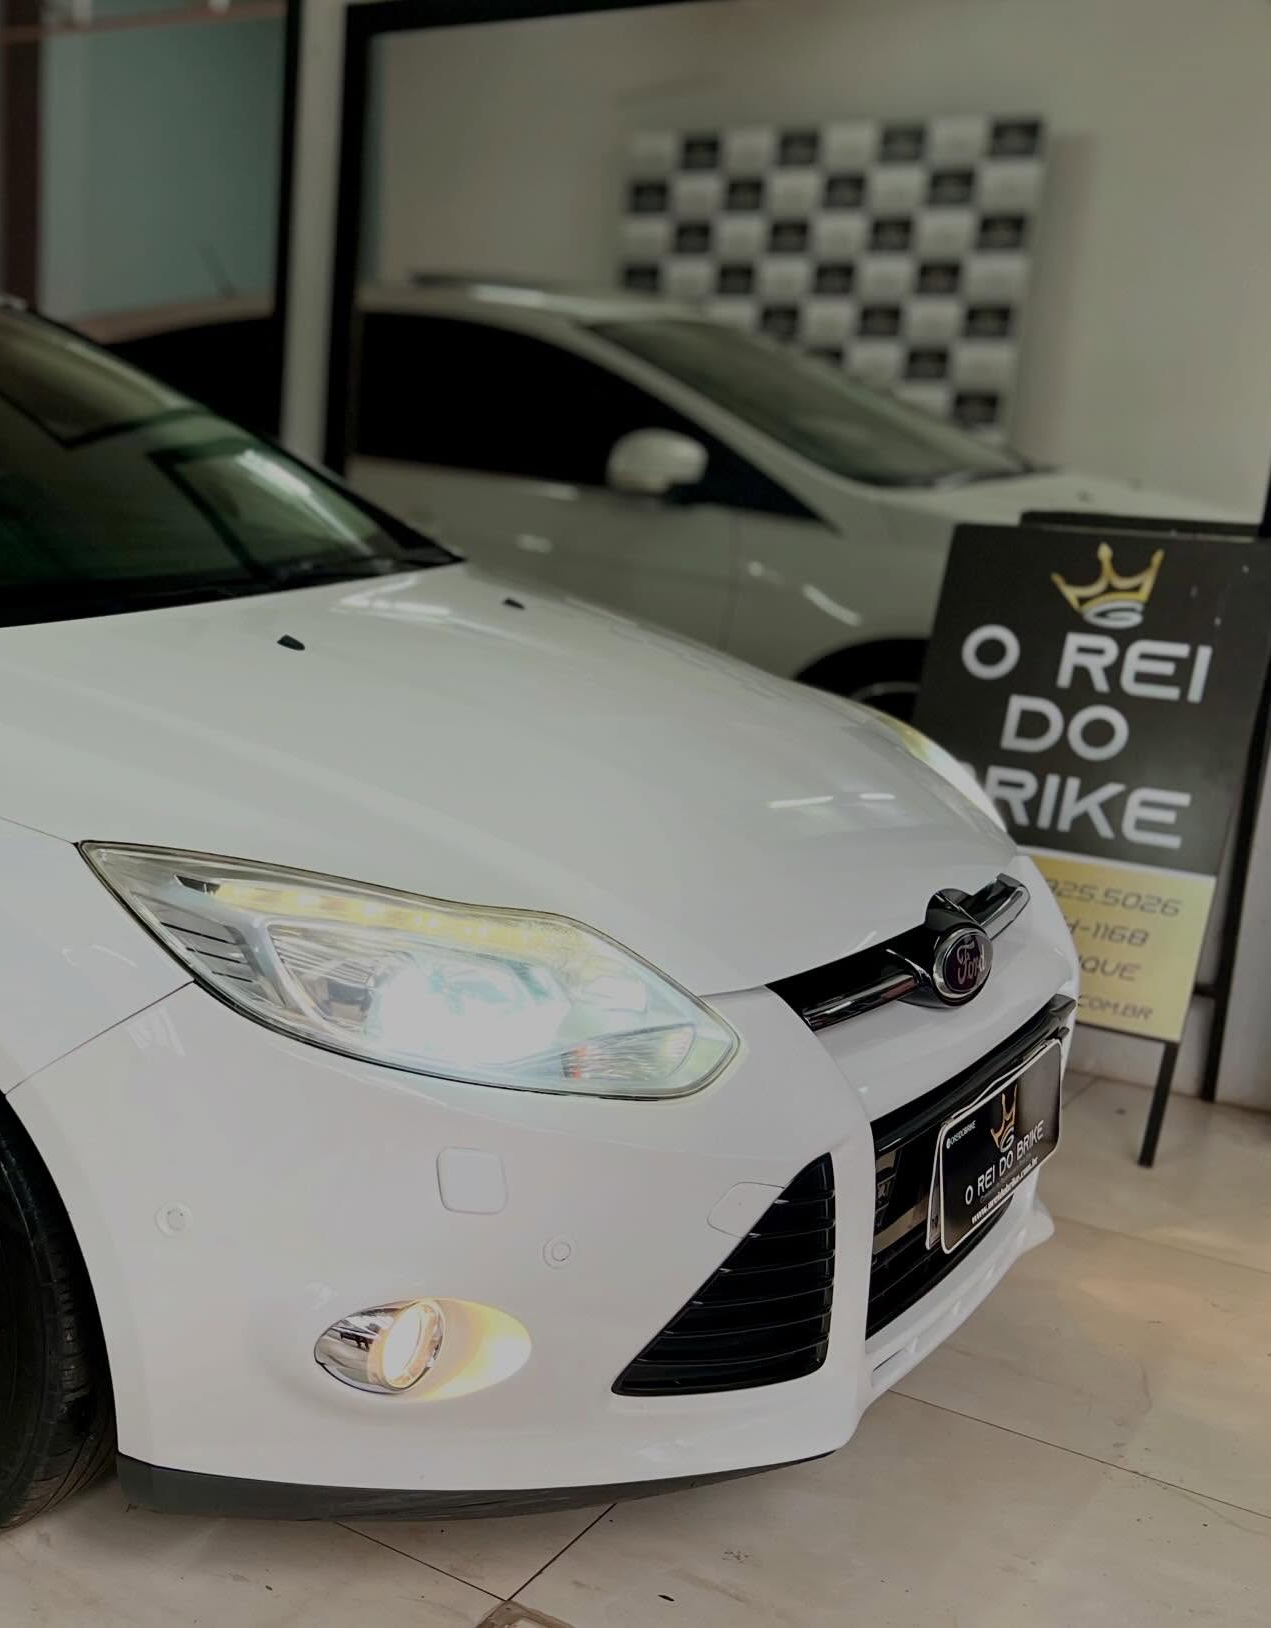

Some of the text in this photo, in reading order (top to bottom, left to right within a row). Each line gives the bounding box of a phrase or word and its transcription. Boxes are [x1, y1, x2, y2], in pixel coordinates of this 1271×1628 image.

[961, 623, 1213, 704] O REI
[1000, 694, 1129, 762] DO
[958, 761, 1192, 849] RIKE
[956, 940, 986, 985] Ford
[965, 1184, 974, 1206] O
[977, 1164, 995, 1197] REI
[999, 1149, 1014, 1177] DO
[1016, 1119, 1045, 1161] BRIKE
